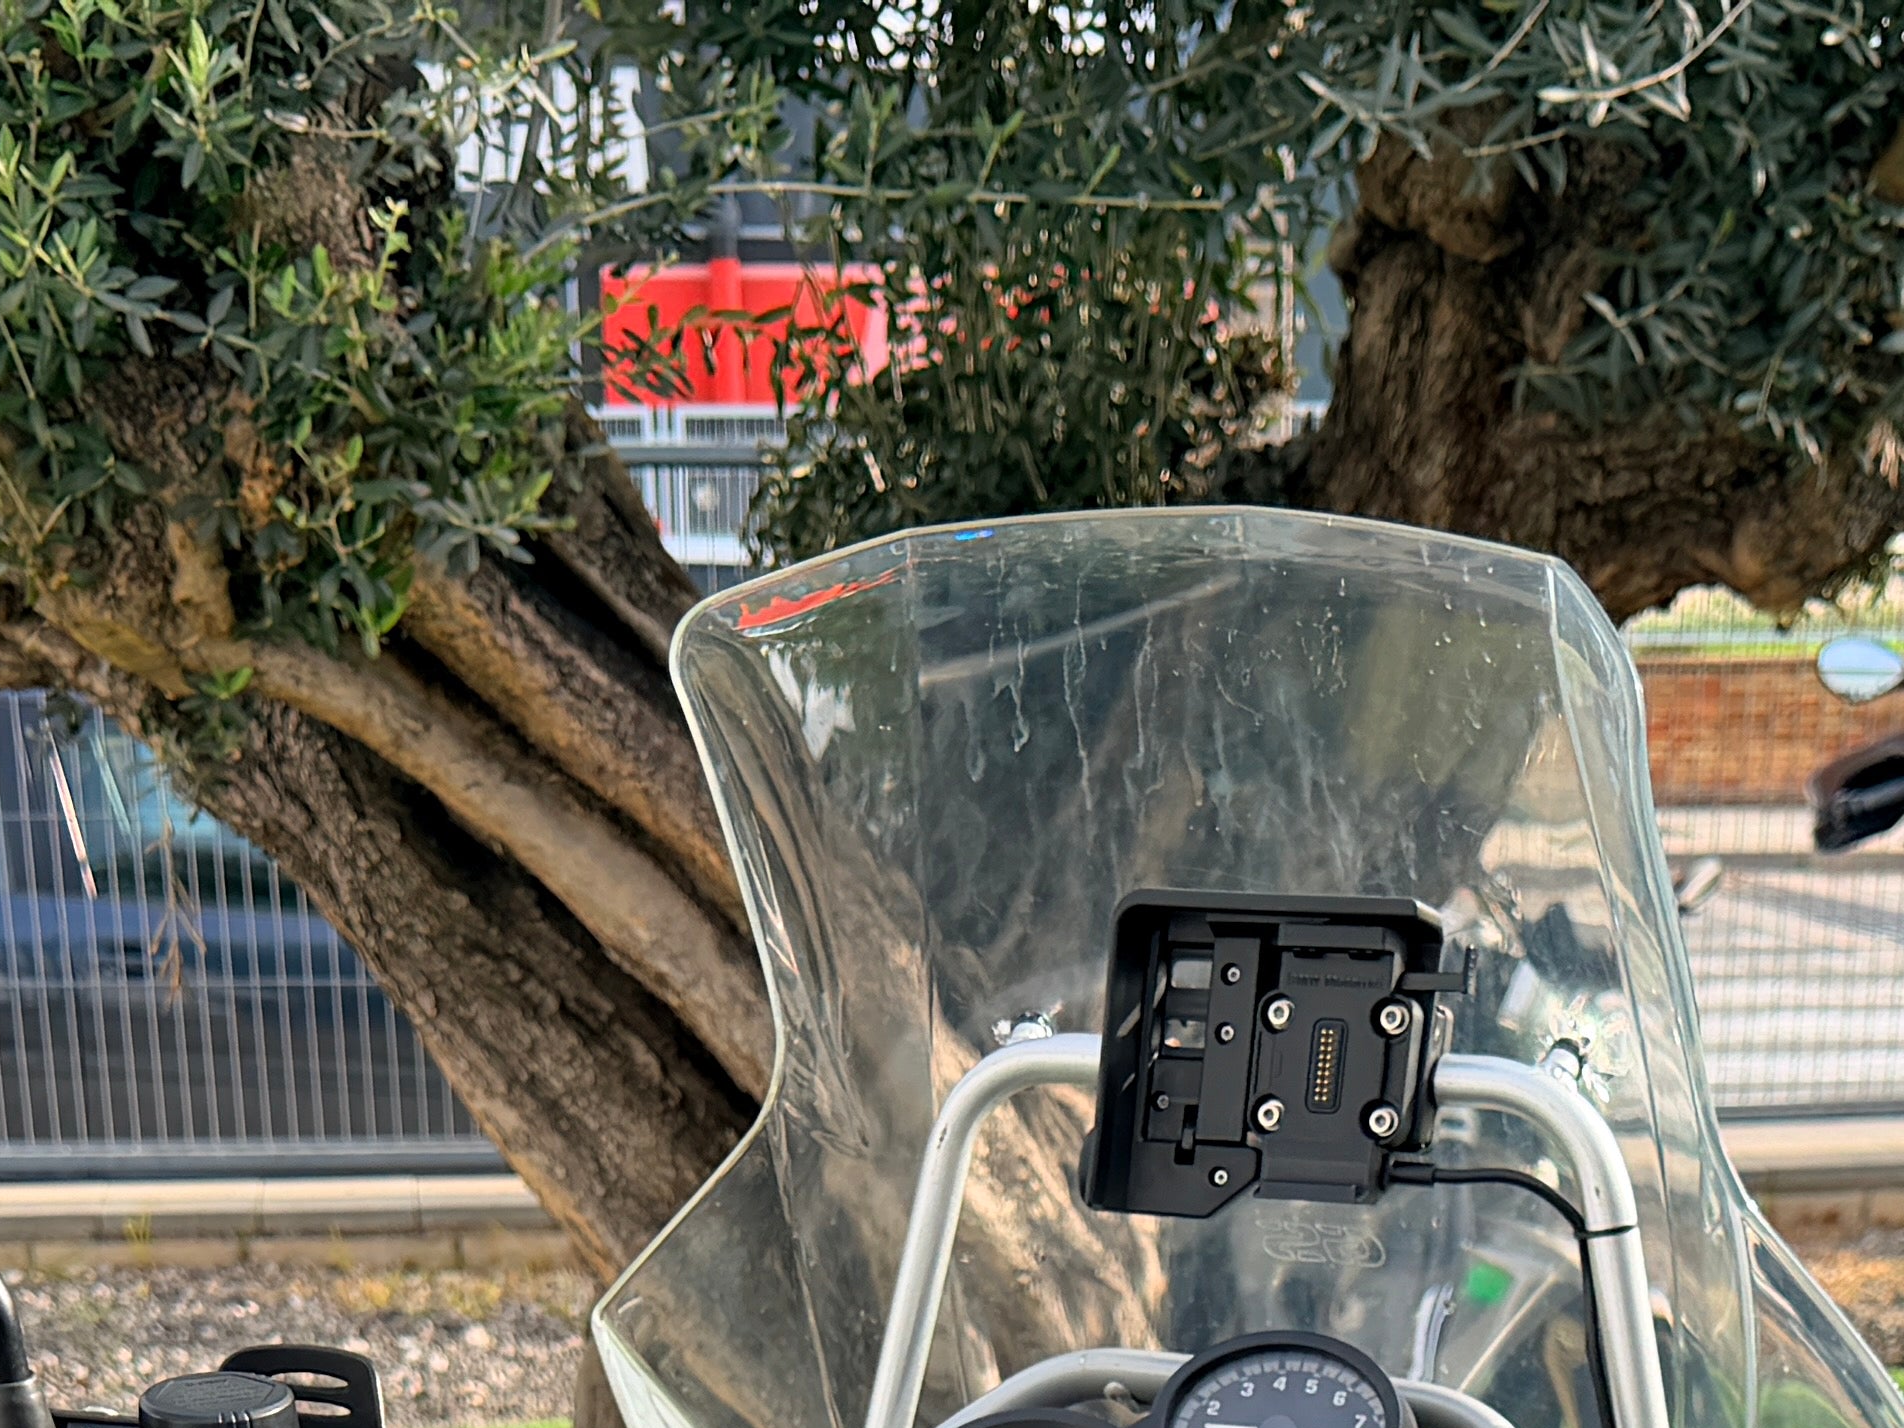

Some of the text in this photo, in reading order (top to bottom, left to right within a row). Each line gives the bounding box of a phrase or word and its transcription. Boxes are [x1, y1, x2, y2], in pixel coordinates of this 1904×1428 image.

[1240, 1382, 1254, 1397] 3
[1273, 1376, 1287, 1392] 4
[1305, 1379, 1320, 1394] 5
[1333, 1391, 1347, 1406] 6
[1206, 1400, 1221, 1416] 2
